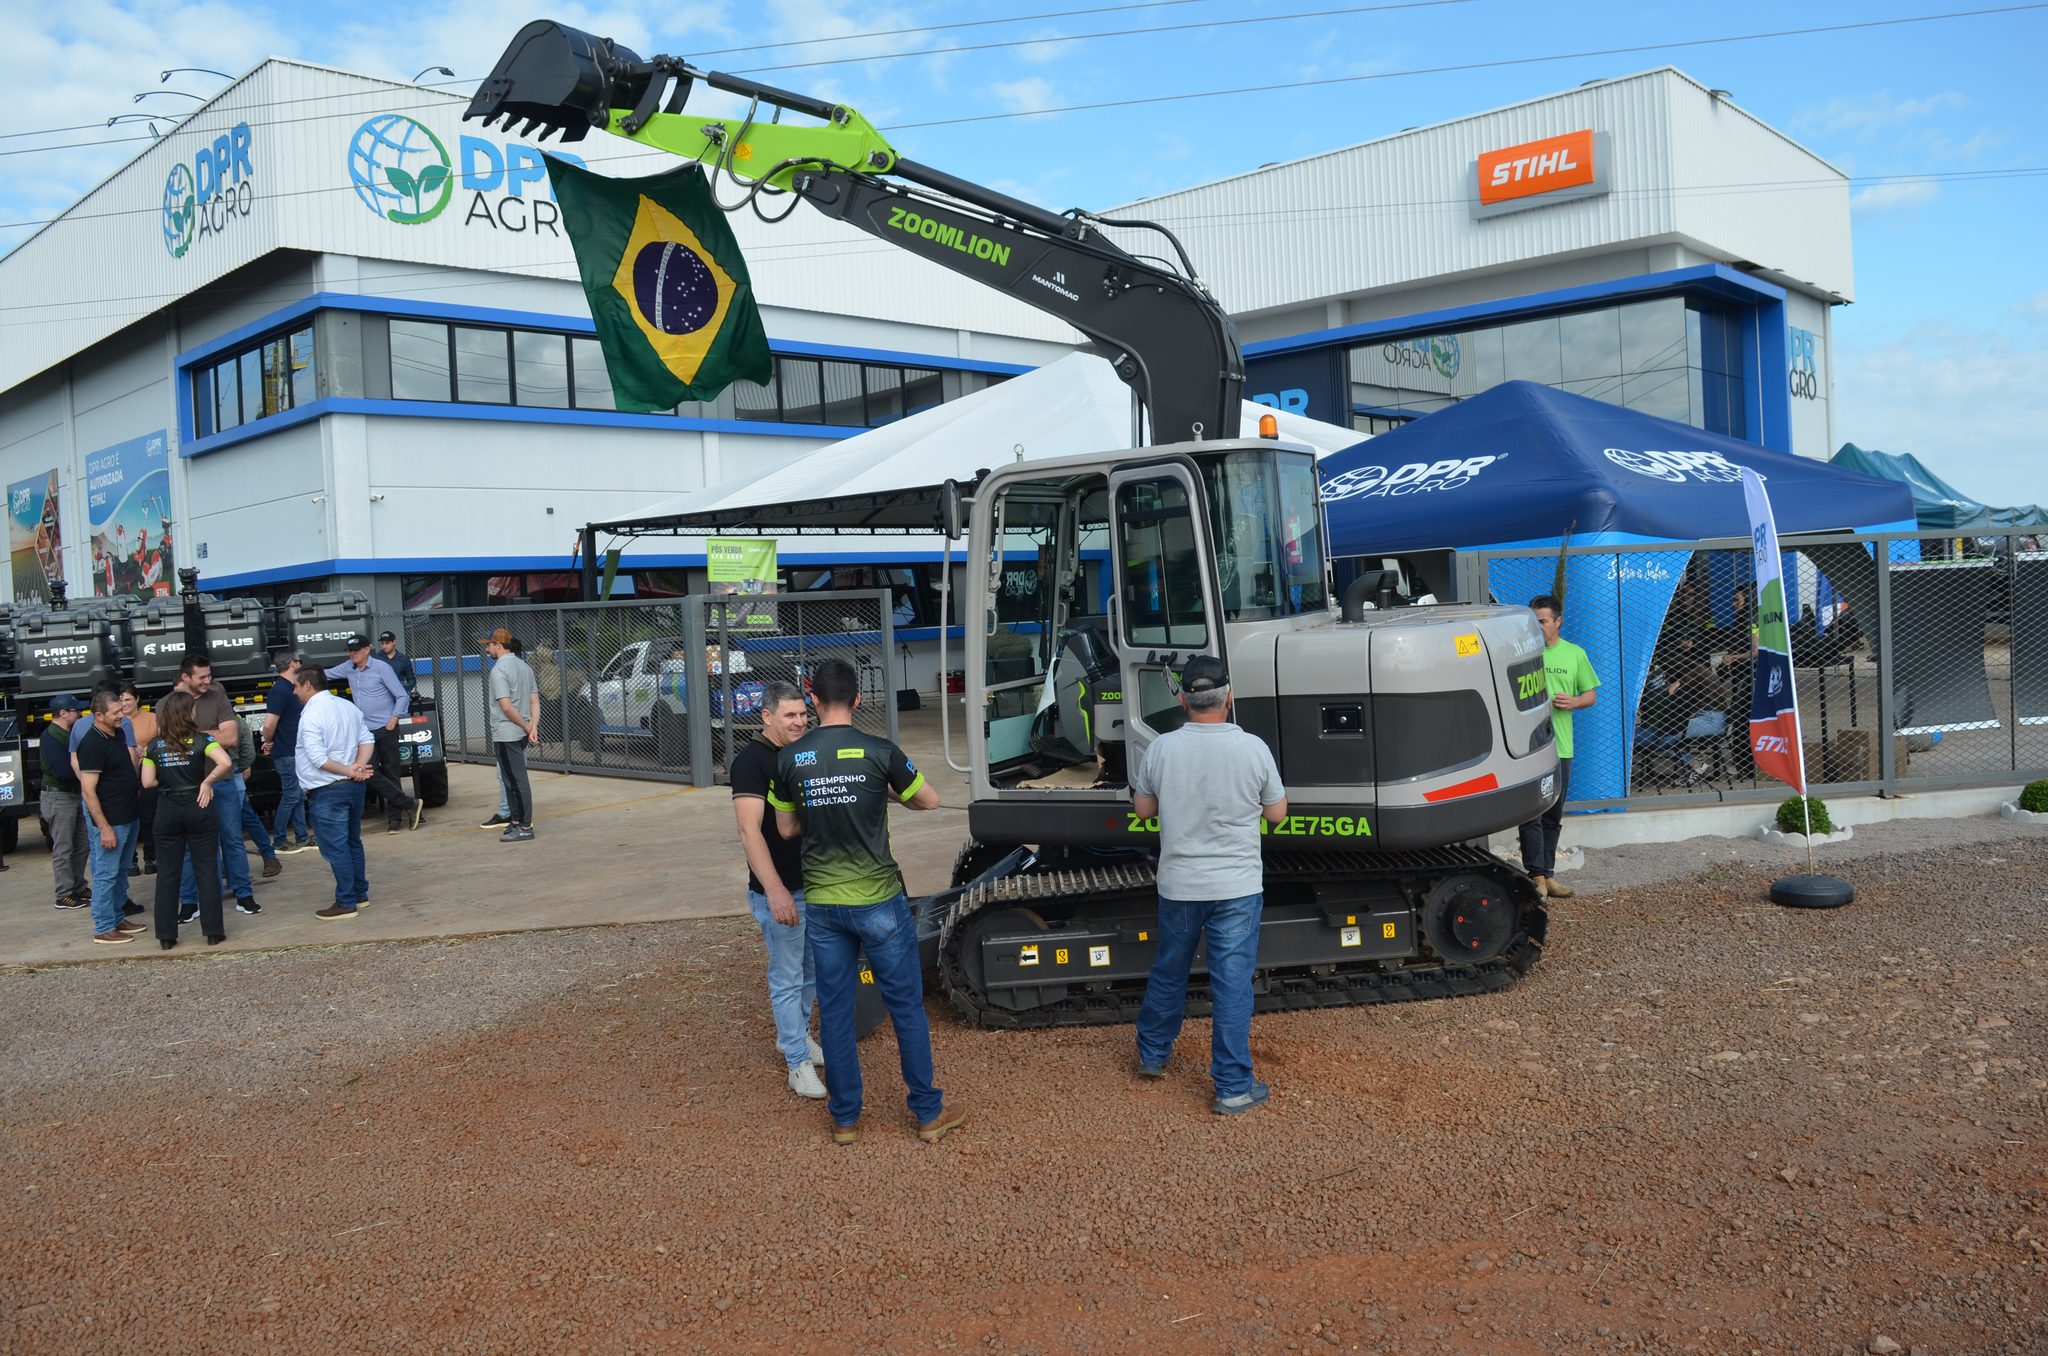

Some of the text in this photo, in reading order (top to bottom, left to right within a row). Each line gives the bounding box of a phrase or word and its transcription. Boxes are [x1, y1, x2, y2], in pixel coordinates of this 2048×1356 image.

[195, 121, 253, 206] DPR
[1491, 149, 1577, 187] STIHL
[199, 181, 252, 243] AGRO
[465, 191, 559, 238] AGR
[887, 206, 1011, 267] ZOOMLION
[1032, 274, 1079, 301] MANTOMAC
[1790, 326, 1816, 374] PR
[1789, 368, 1817, 400] GRO
[1381, 455, 1496, 486] DPR
[1644, 451, 1742, 470] DPR
[1362, 476, 1471, 499] AGRO
[724, 545, 742, 553] VENDA
[34, 645, 88, 658] PLANTIO
[212, 637, 253, 649] PLUS
[40, 655, 87, 667] DIRETO
[794, 751, 816, 762] DPR
[795, 759, 817, 768] AGRO
[804, 775, 866, 787] DESEMPENHO
[806, 785, 848, 797] POTÊNCIA
[807, 795, 857, 807] RESULTADO
[1274, 815, 1372, 836] ZE75GA
